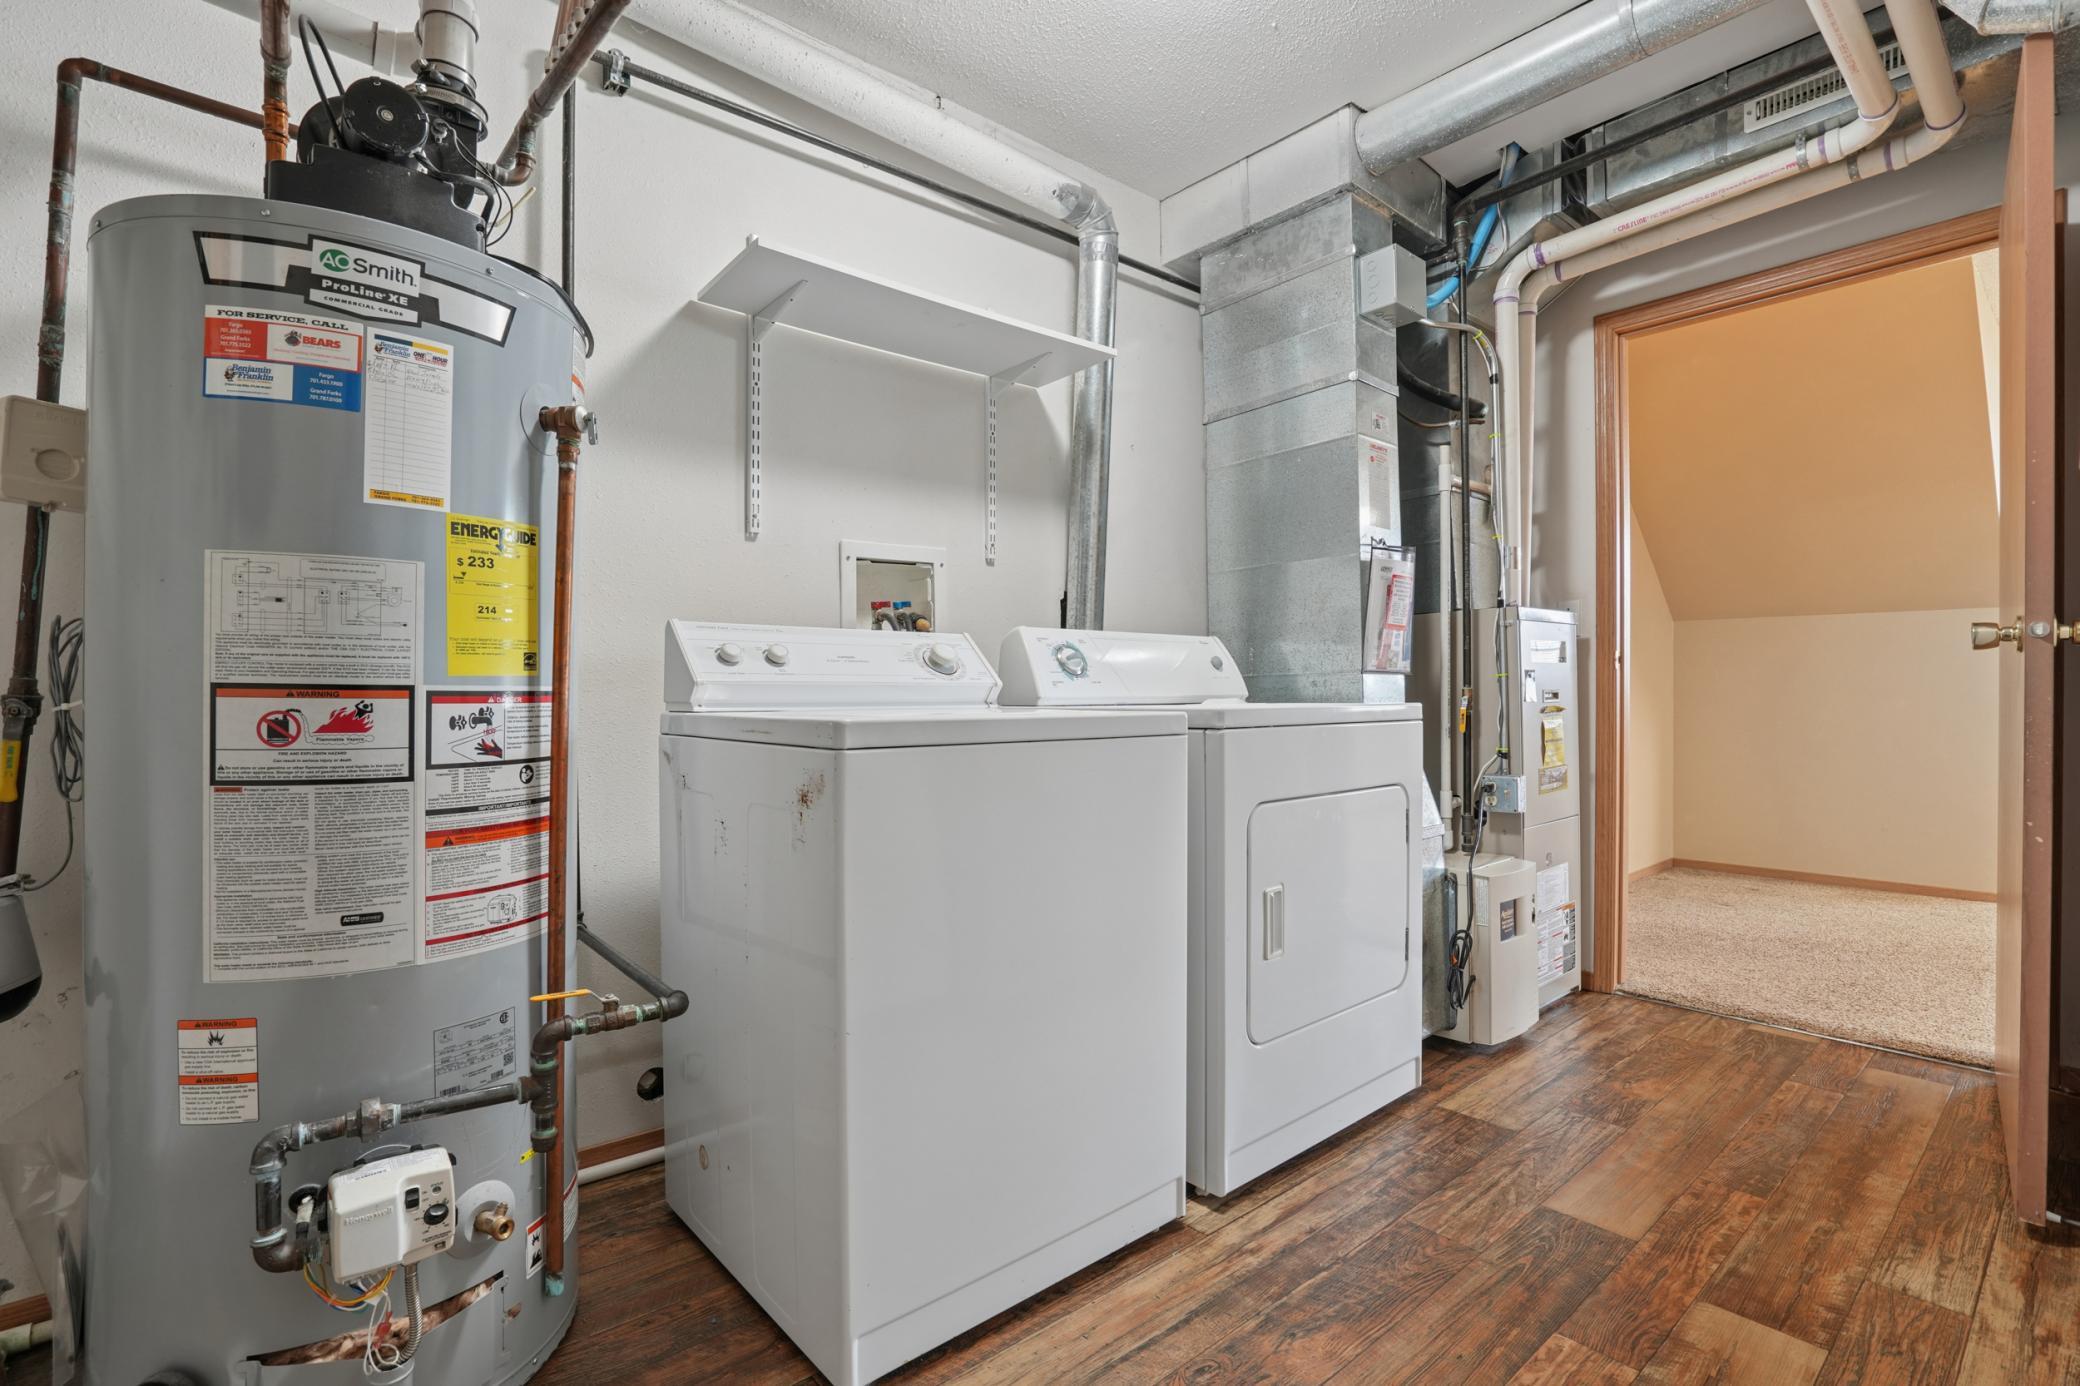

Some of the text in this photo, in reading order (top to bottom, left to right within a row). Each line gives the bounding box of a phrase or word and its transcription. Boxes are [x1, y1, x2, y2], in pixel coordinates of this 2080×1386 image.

[353, 258, 414, 286] Smith
[321, 279, 408, 306] ProLine XE
[324, 296, 404, 317] COMMERCIAL GRADE
[217, 309, 348, 330] FOR SERVICE, CALL
[302, 336, 342, 349] BEARS
[232, 363, 272, 374] Benjamin
[238, 372, 274, 382] Franklin
[456, 556, 494, 569] $ 233
[478, 605, 497, 616] 214
[296, 690, 340, 698] WARNING
